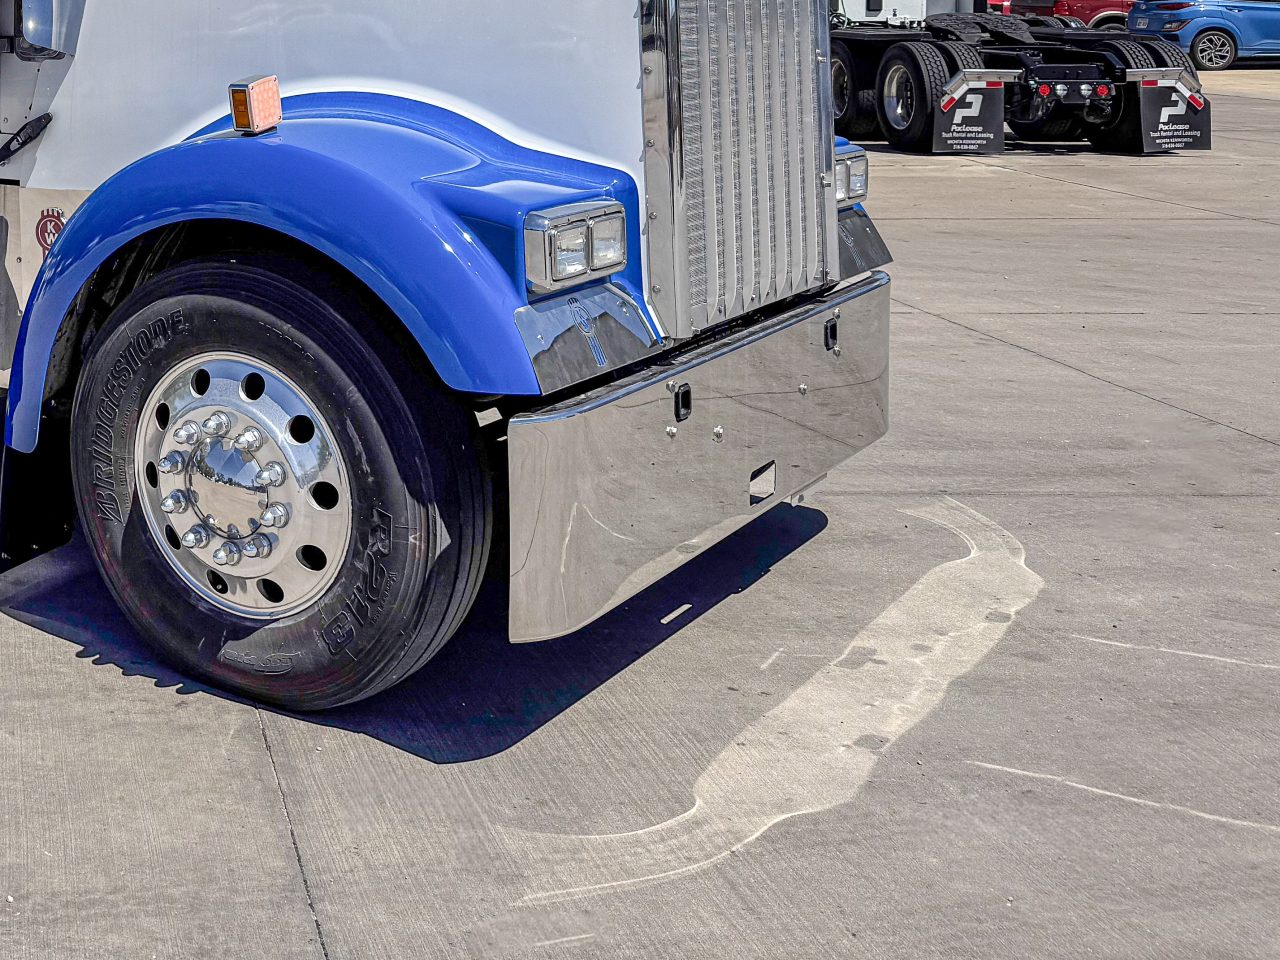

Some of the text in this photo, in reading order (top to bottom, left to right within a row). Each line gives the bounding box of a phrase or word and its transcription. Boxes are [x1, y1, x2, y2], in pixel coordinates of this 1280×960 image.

[951, 124, 983, 132] PacLease
[1158, 123, 1190, 131] PacLease
[92, 307, 184, 524] BRIDGESTONE
